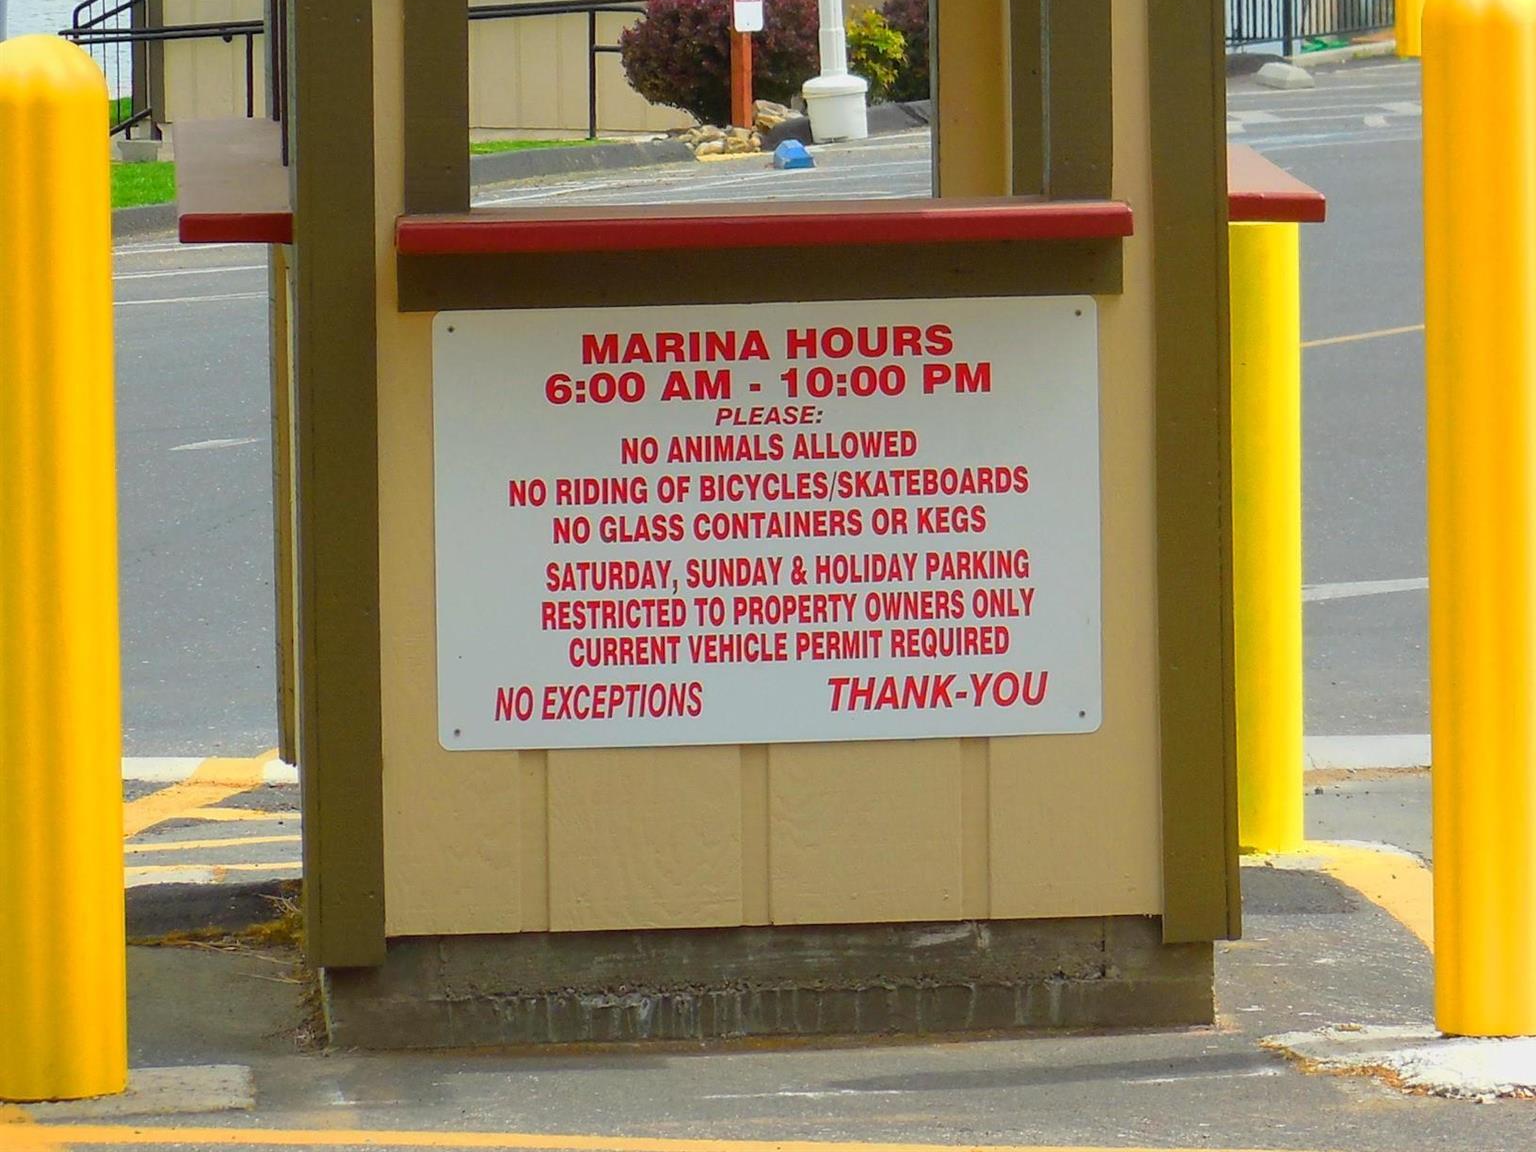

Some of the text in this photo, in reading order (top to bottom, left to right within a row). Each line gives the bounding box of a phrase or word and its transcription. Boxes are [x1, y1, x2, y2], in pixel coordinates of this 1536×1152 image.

[581, 322, 956, 366] MARINA HOURS
[545, 360, 993, 406] 6:00 AM - 10:00 PM
[716, 403, 824, 427] PLEASE:
[620, 429, 920, 466] NO ANIMALS ALLOWED
[508, 464, 1031, 509] NO RIDING OF BICYCLES/SKATEBOARDS
[552, 504, 988, 545] NO GLASS CONTAINERS OR KEGS
[545, 548, 1032, 594] SATURDAY, SUNDAY & HOLIDAY PARKING
[541, 587, 1036, 631] RESTRICTED TO PROPERTY OWNERS ONLY
[568, 624, 1012, 668] CURRENT VEHICLE PERMIT REQUIRED
[495, 681, 704, 722] NO EXCEPTIONS
[827, 670, 1049, 712] THANK-YOU
